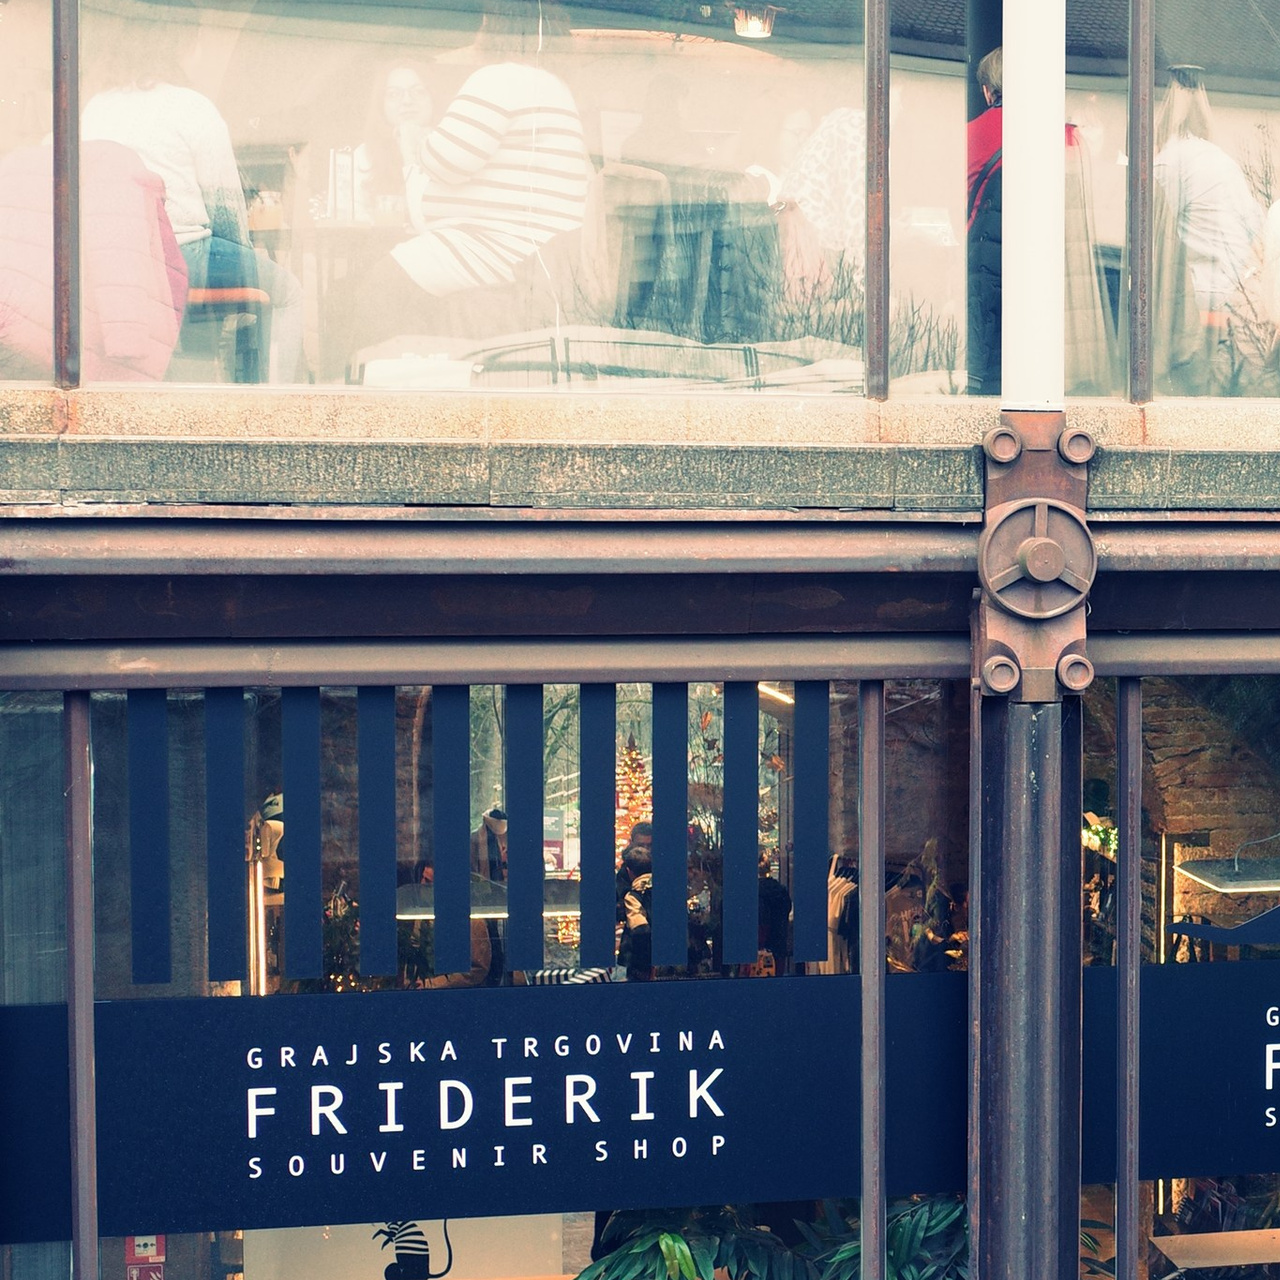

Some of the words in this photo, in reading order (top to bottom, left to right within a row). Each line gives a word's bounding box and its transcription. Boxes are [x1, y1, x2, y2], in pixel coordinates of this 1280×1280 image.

[246, 1040, 458, 1069] GRAJSKA
[491, 1029, 725, 1059] TRGOVINA
[247, 1068, 725, 1139] FRIDERIK
[248, 1143, 548, 1179] SOUVENIR
[595, 1135, 726, 1162] SHOP
